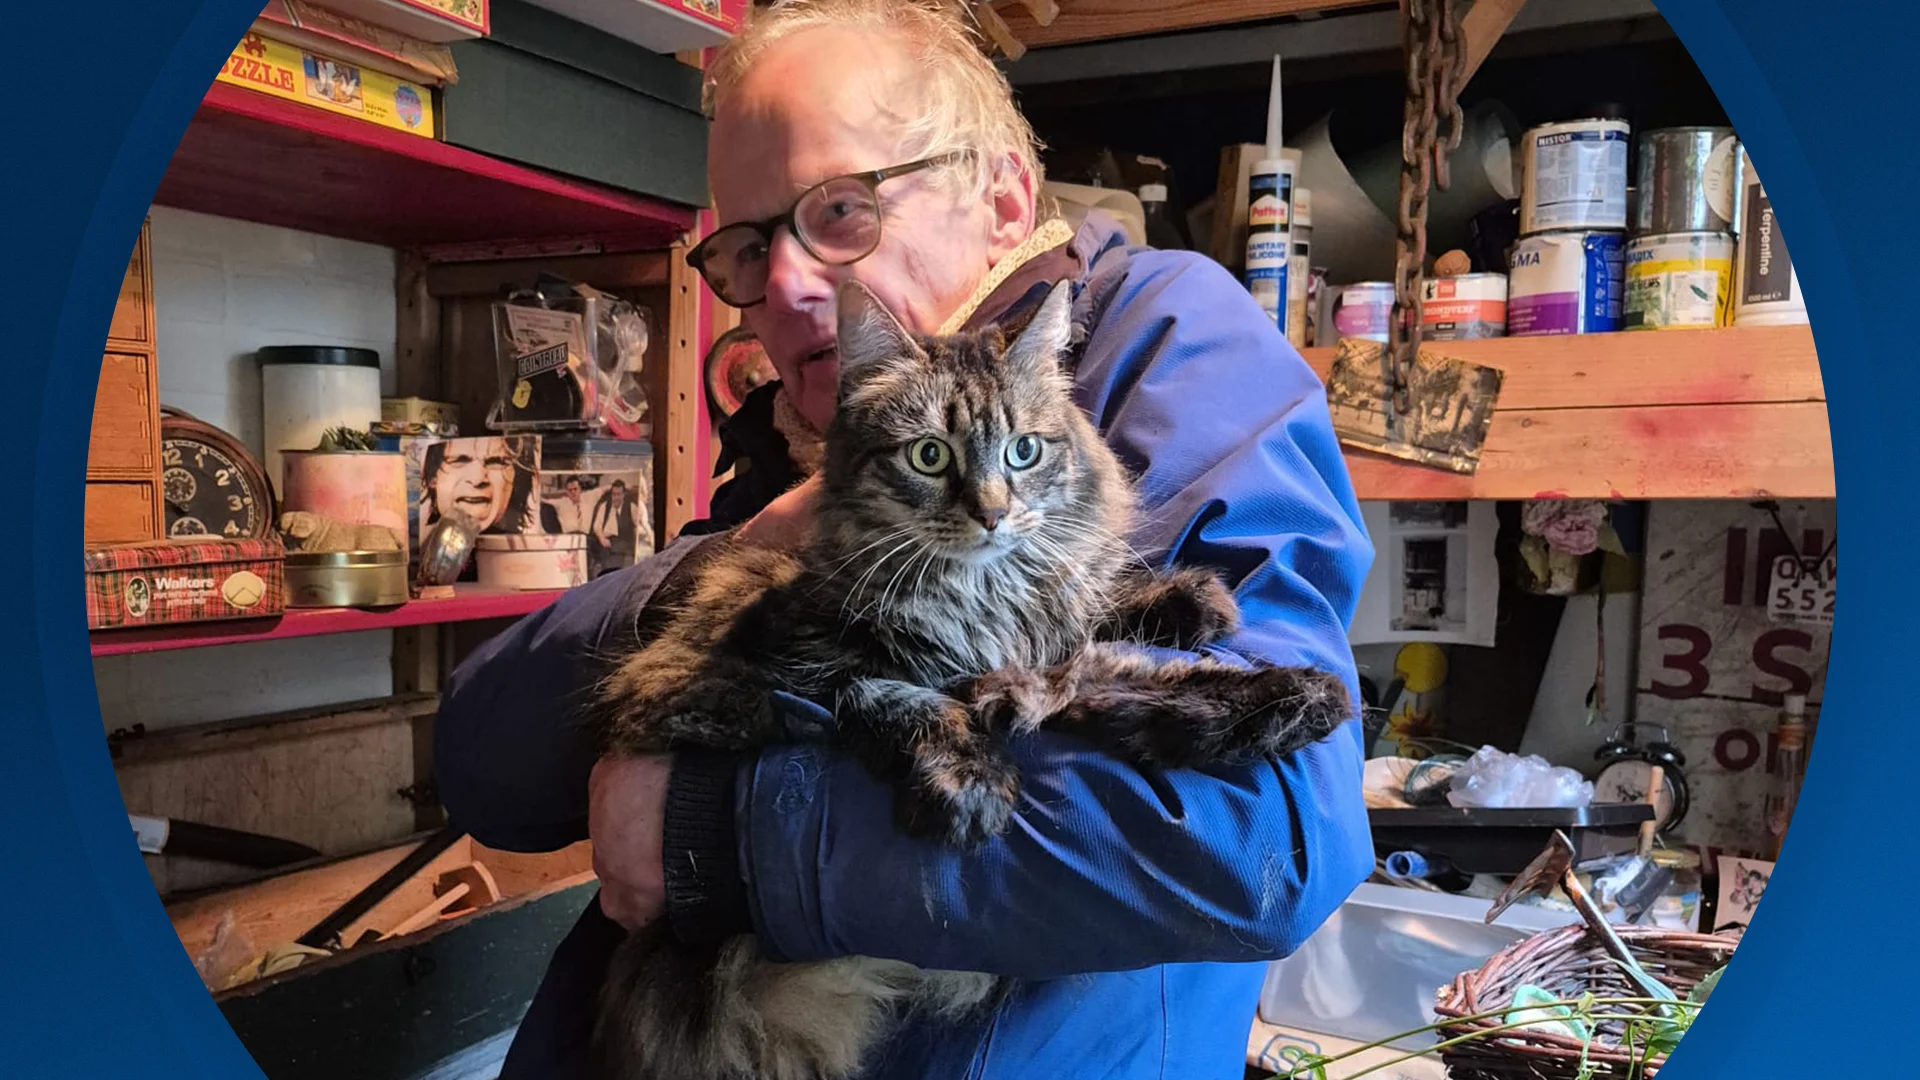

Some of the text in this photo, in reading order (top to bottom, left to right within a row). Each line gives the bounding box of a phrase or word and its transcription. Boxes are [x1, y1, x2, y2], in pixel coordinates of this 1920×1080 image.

[1252, 205, 1285, 217] Pattex
[1759, 207, 1774, 276] Terpentine
[162, 448, 183, 466] 12
[195, 452, 204, 469] 1
[215, 469, 231, 486] 2
[227, 495, 243, 511] 3
[223, 520, 240, 536] 4
[154, 575, 215, 590] Walkers
[1775, 587, 1836, 613] 552
[1650, 623, 1814, 705] 3 S
